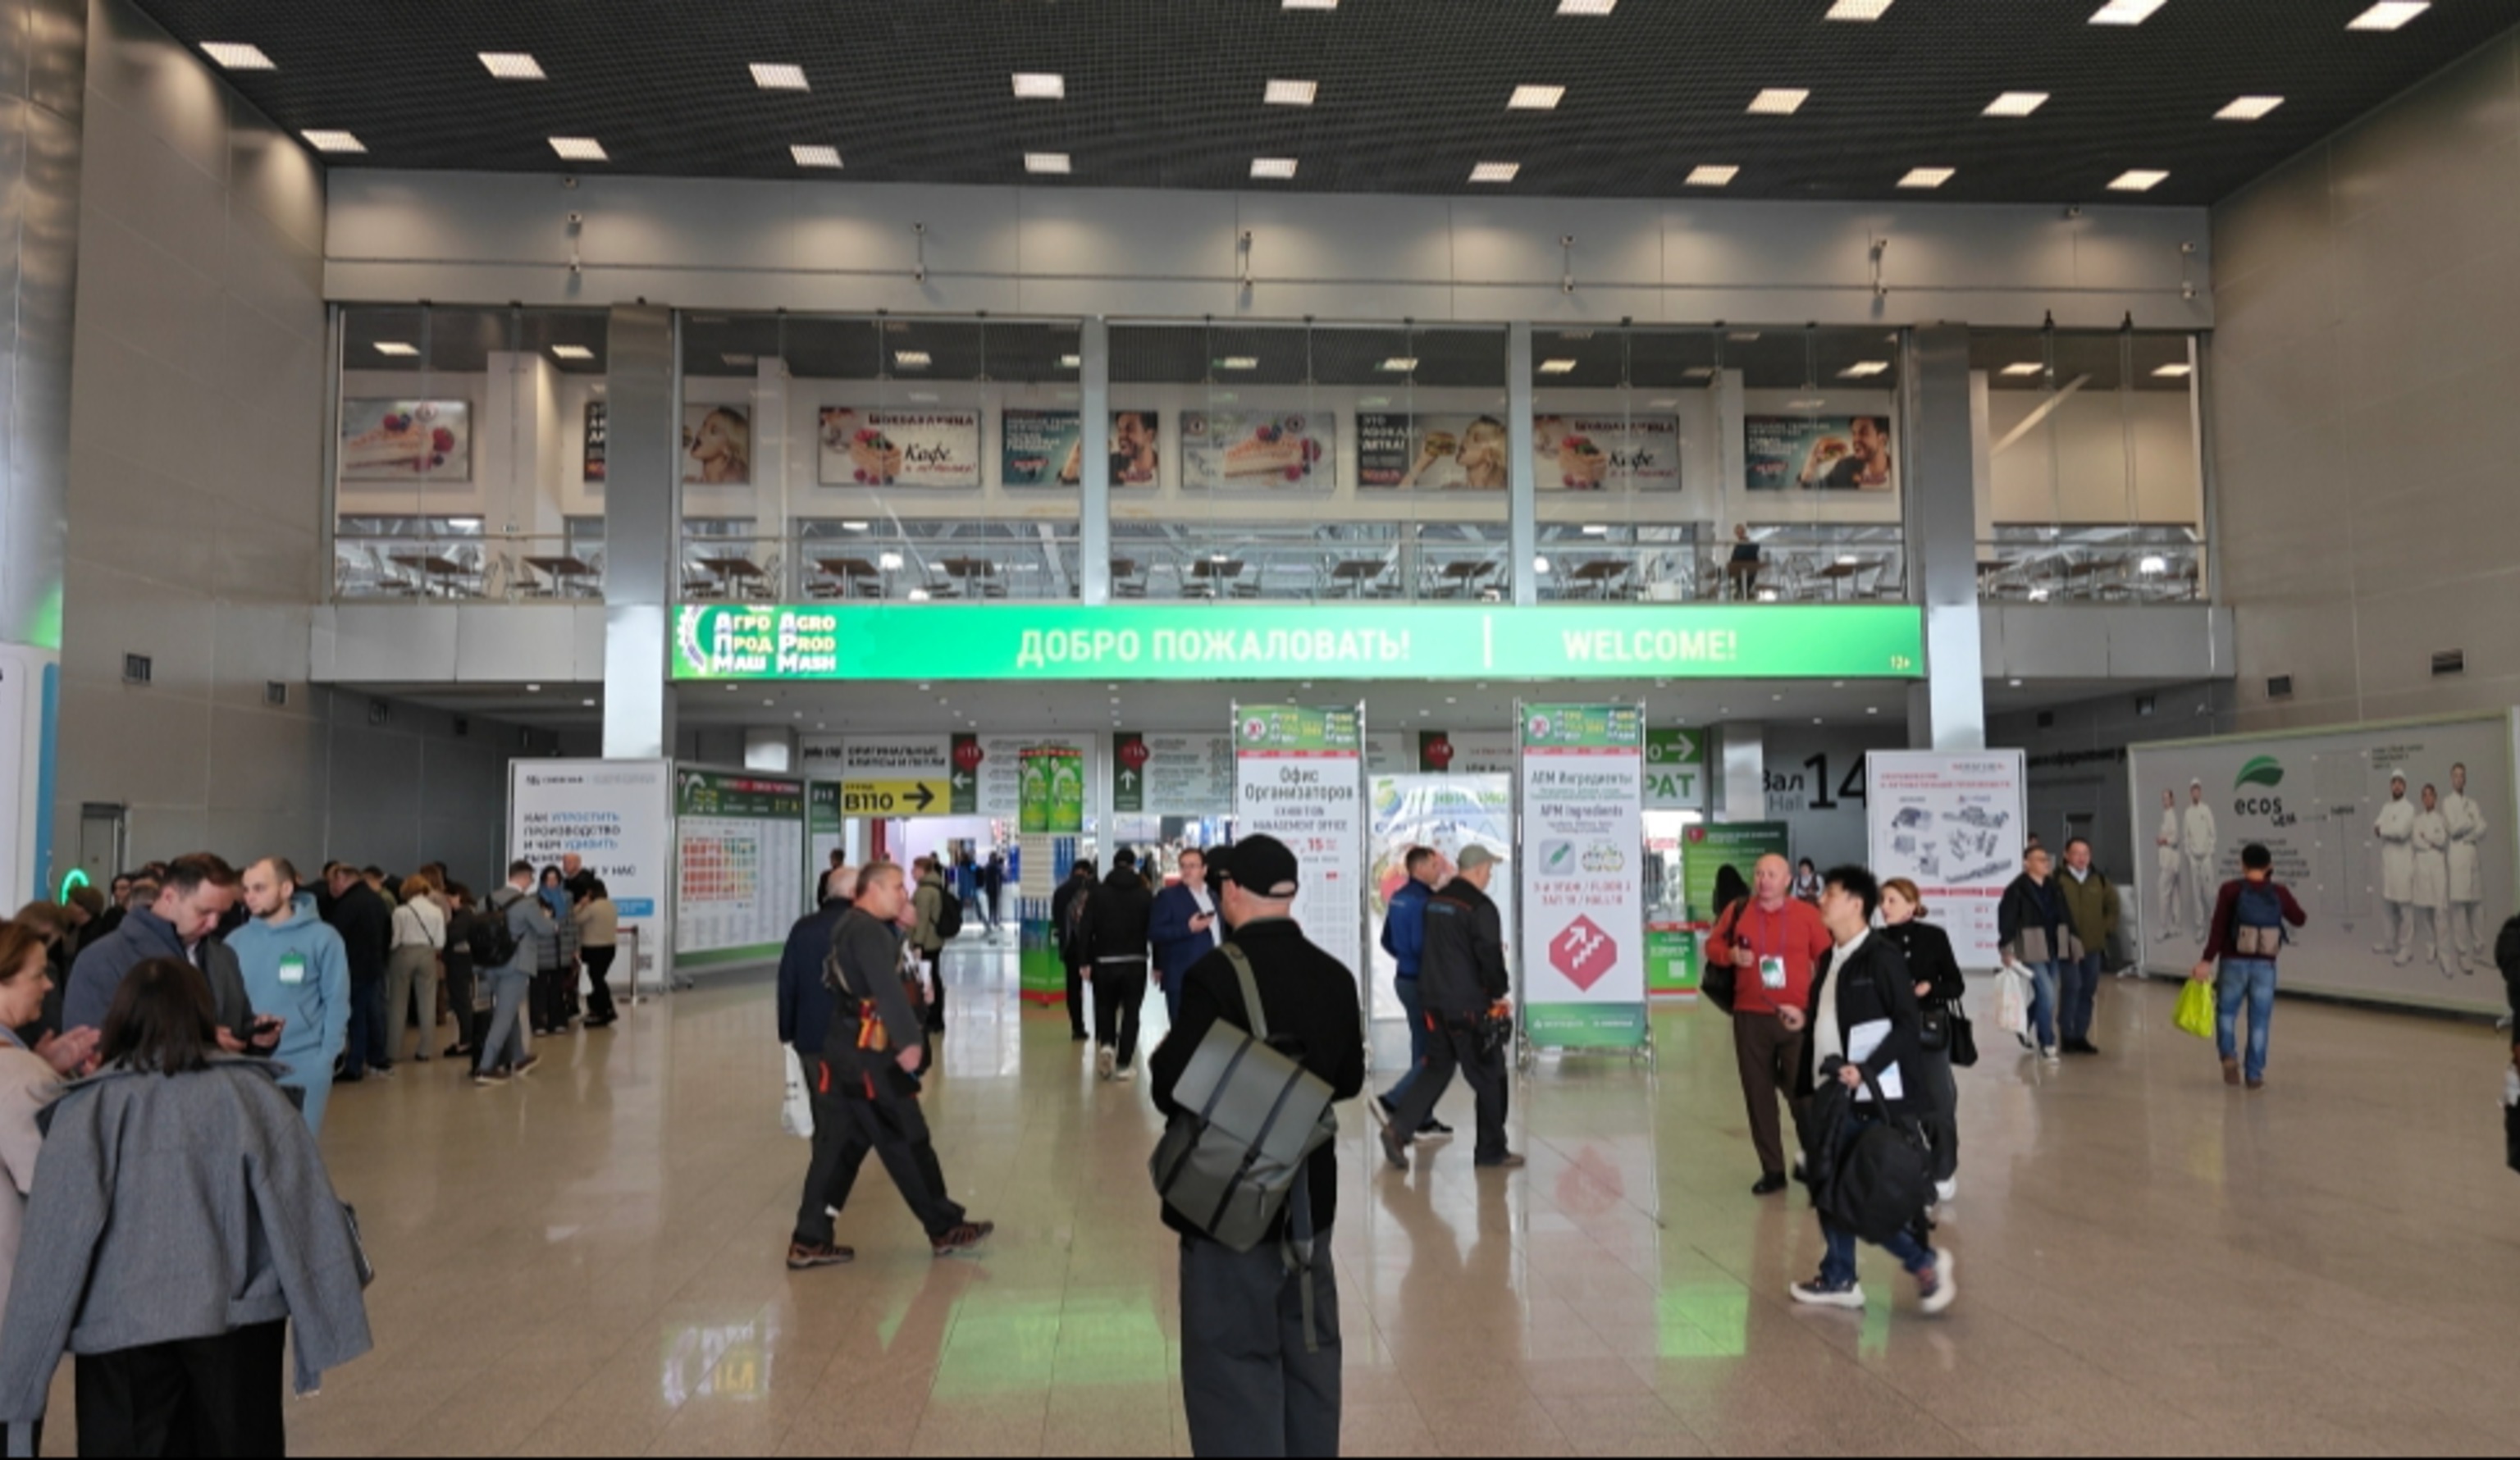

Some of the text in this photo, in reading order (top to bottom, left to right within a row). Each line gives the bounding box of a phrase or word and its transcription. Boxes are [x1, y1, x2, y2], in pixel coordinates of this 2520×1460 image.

[778, 611, 837, 632] AGRO
[778, 633, 837, 655] PROD
[1016, 628, 1412, 669] ДОБРО ПОЖАЛОВАТЬ!
[1562, 629, 1738, 661] WELCOME!
[776, 655, 837, 673] MASH
[1280, 766, 1319, 785] Офис
[1803, 752, 1867, 810] 14
[844, 793, 894, 811] B110
[1244, 783, 1354, 803] Организаторов
[2234, 796, 2283, 815] ecos
[523, 825, 621, 837] ПРОИЗВОДСТВО
